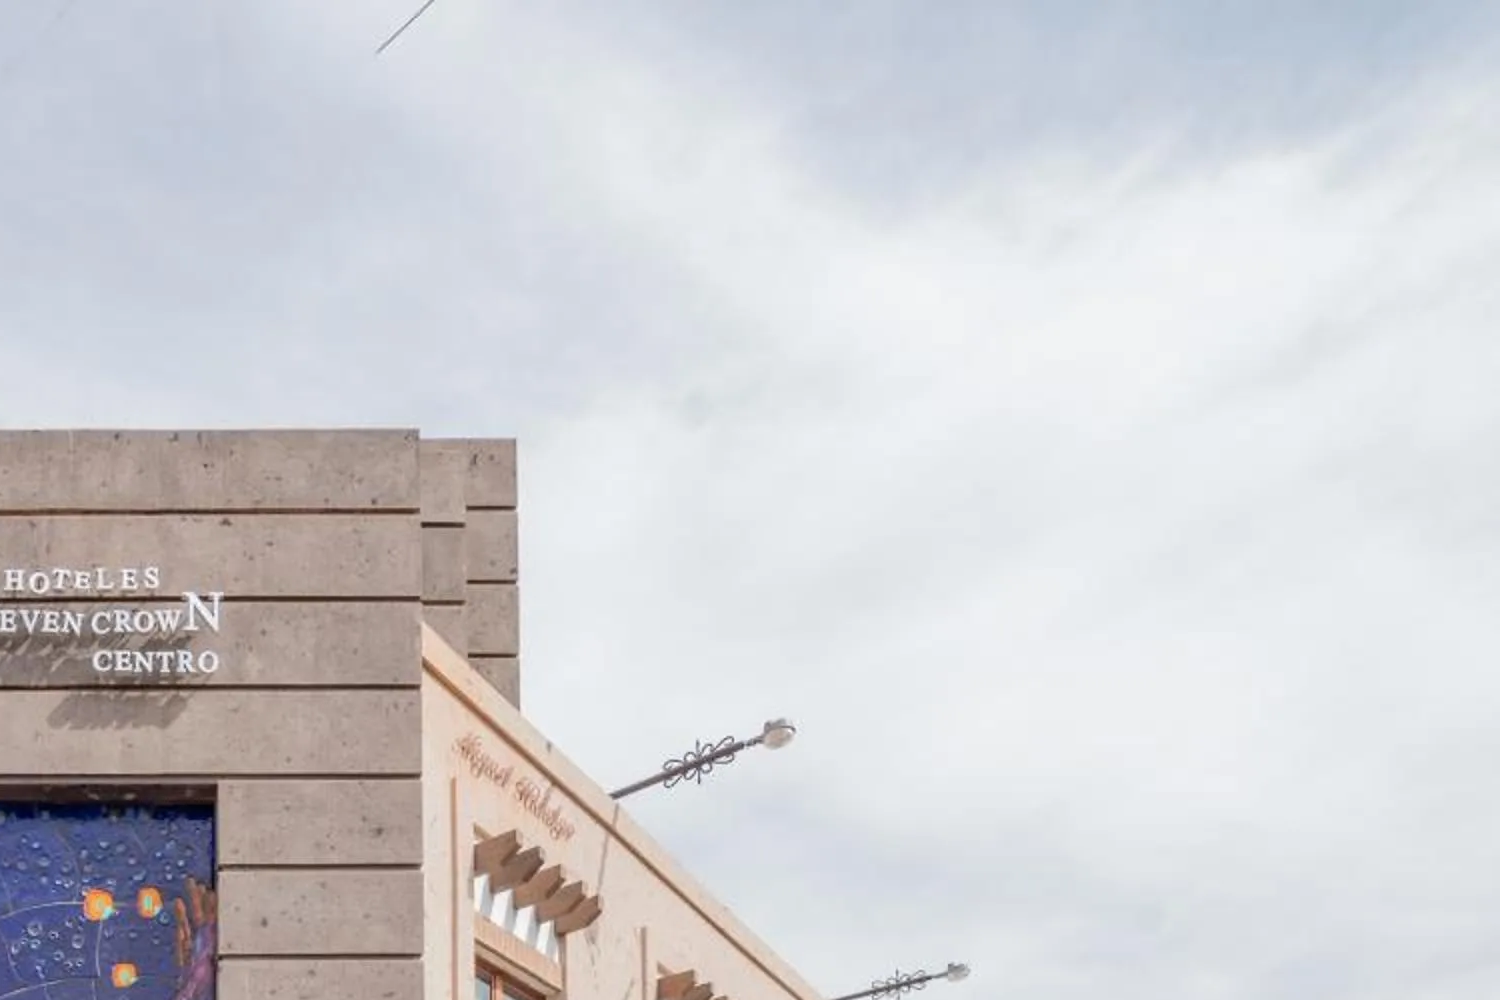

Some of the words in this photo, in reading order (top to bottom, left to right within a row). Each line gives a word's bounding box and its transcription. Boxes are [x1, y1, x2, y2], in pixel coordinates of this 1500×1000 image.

[3, 566, 161, 594] HOTELES
[90, 591, 224, 634] CROWN
[92, 650, 219, 674] CENTRO
